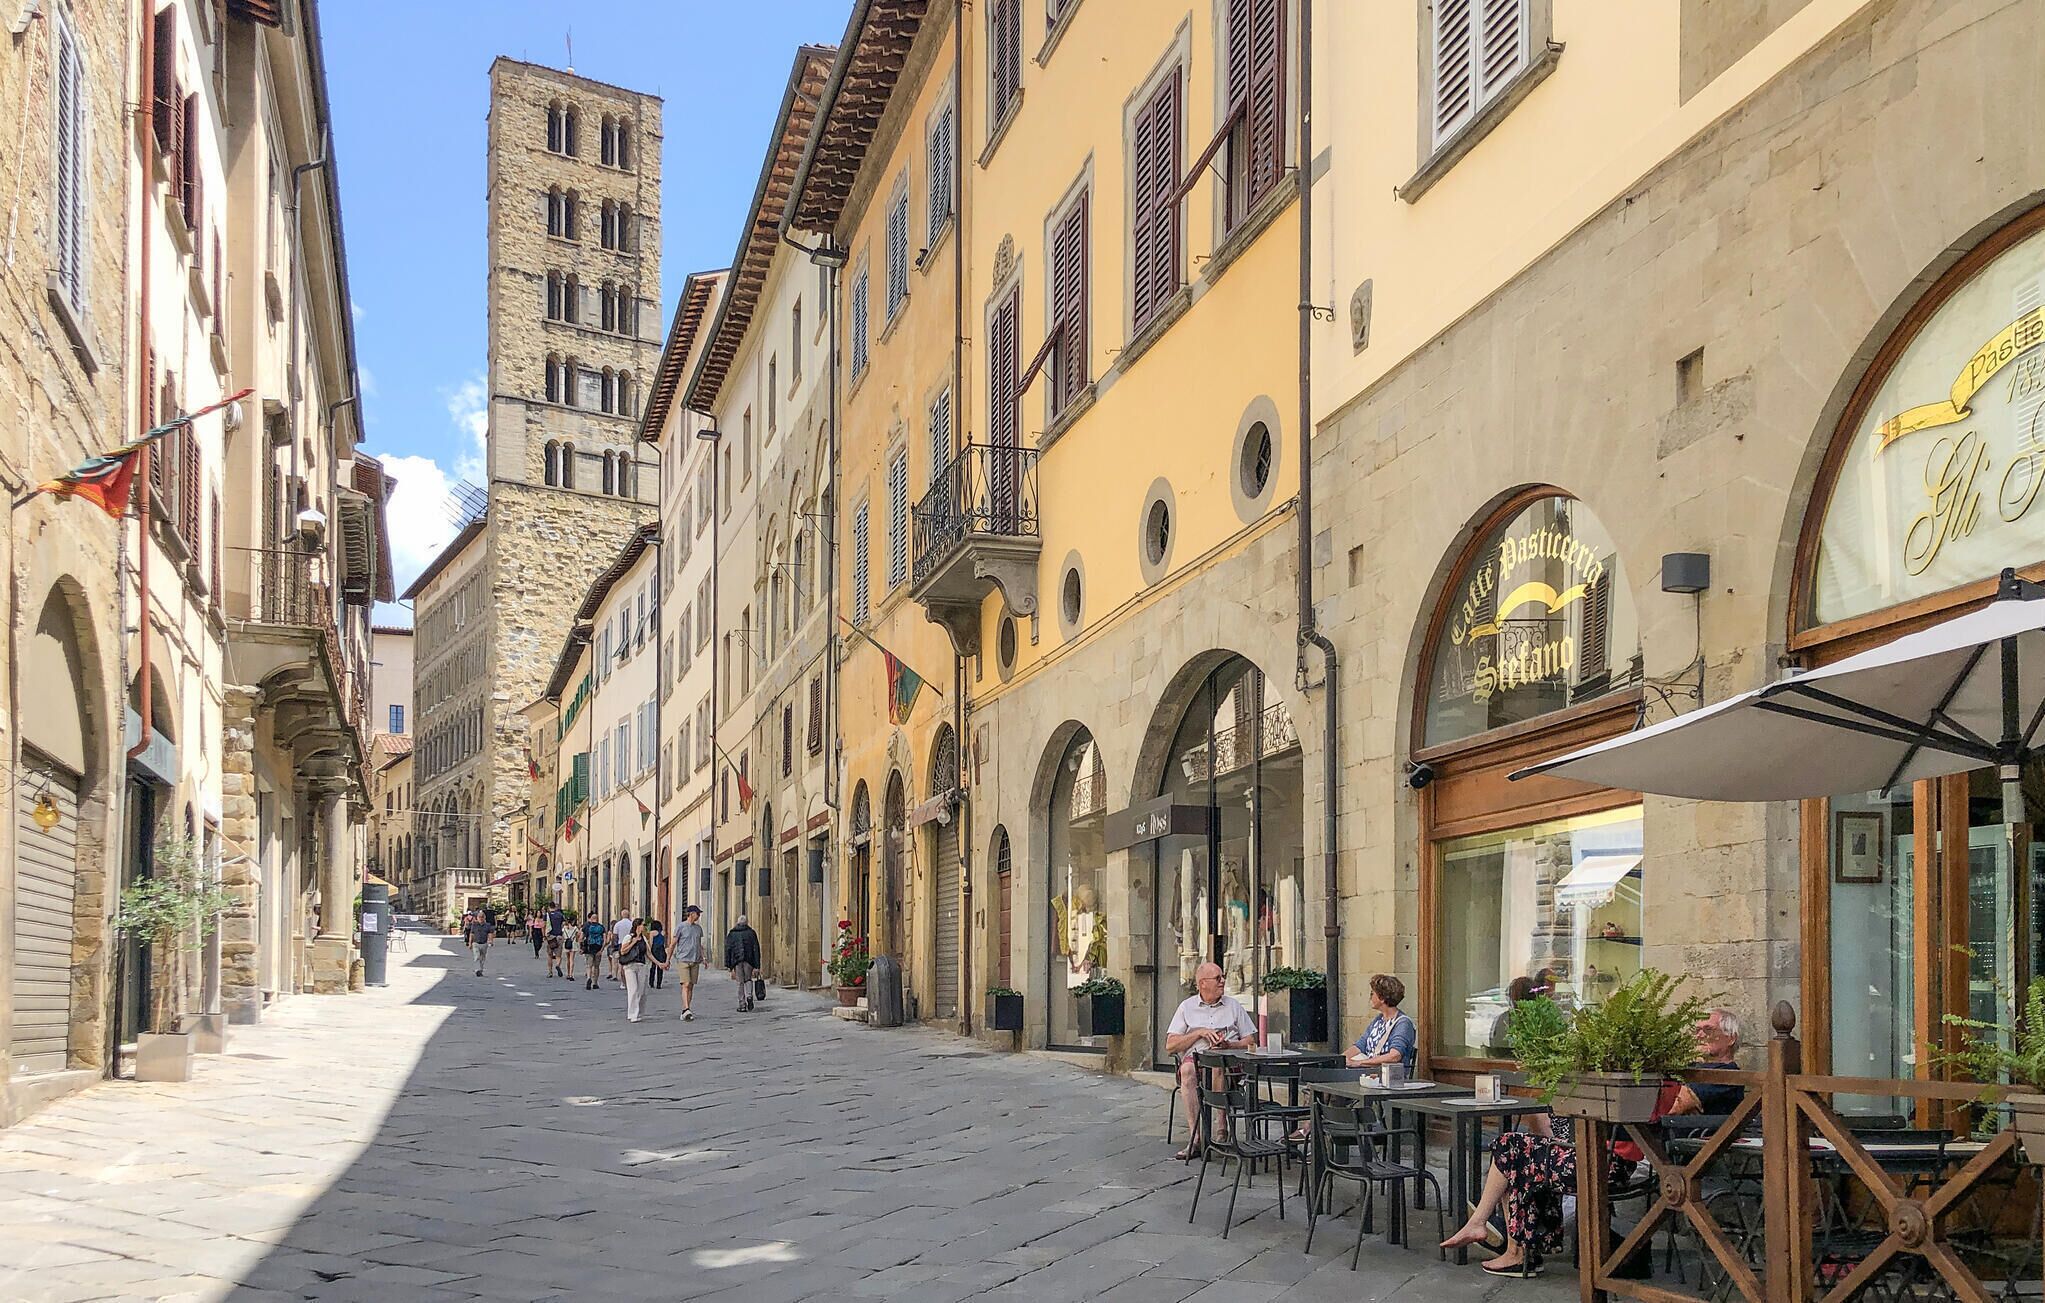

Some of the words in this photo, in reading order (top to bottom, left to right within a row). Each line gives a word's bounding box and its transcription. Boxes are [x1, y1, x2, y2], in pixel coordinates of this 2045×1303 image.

[1903, 430, 1990, 577] Gli
[1499, 523, 1604, 589] Pasticceria
[1473, 636, 1574, 704] Stefano
